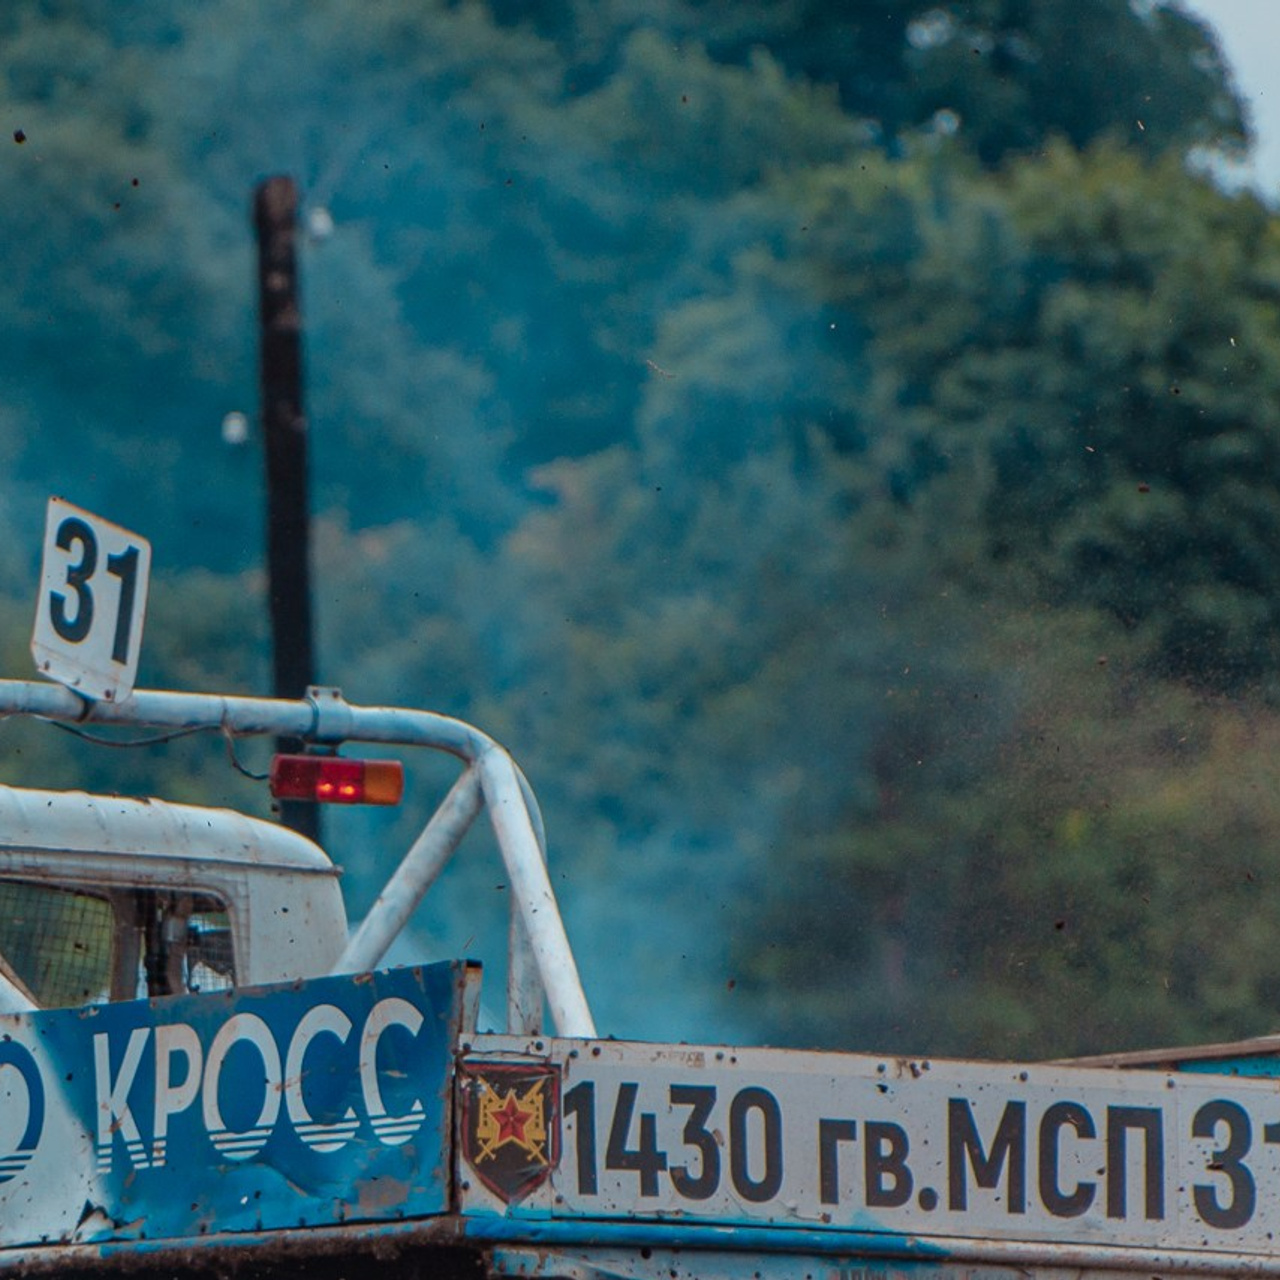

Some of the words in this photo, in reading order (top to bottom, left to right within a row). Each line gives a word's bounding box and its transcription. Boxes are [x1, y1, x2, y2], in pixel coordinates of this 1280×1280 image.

[49, 516, 140, 665] 31
[93, 997, 428, 1175] КРОСС
[563, 1081, 784, 1203] 1430
[1191, 1098, 1280, 1230] 3
